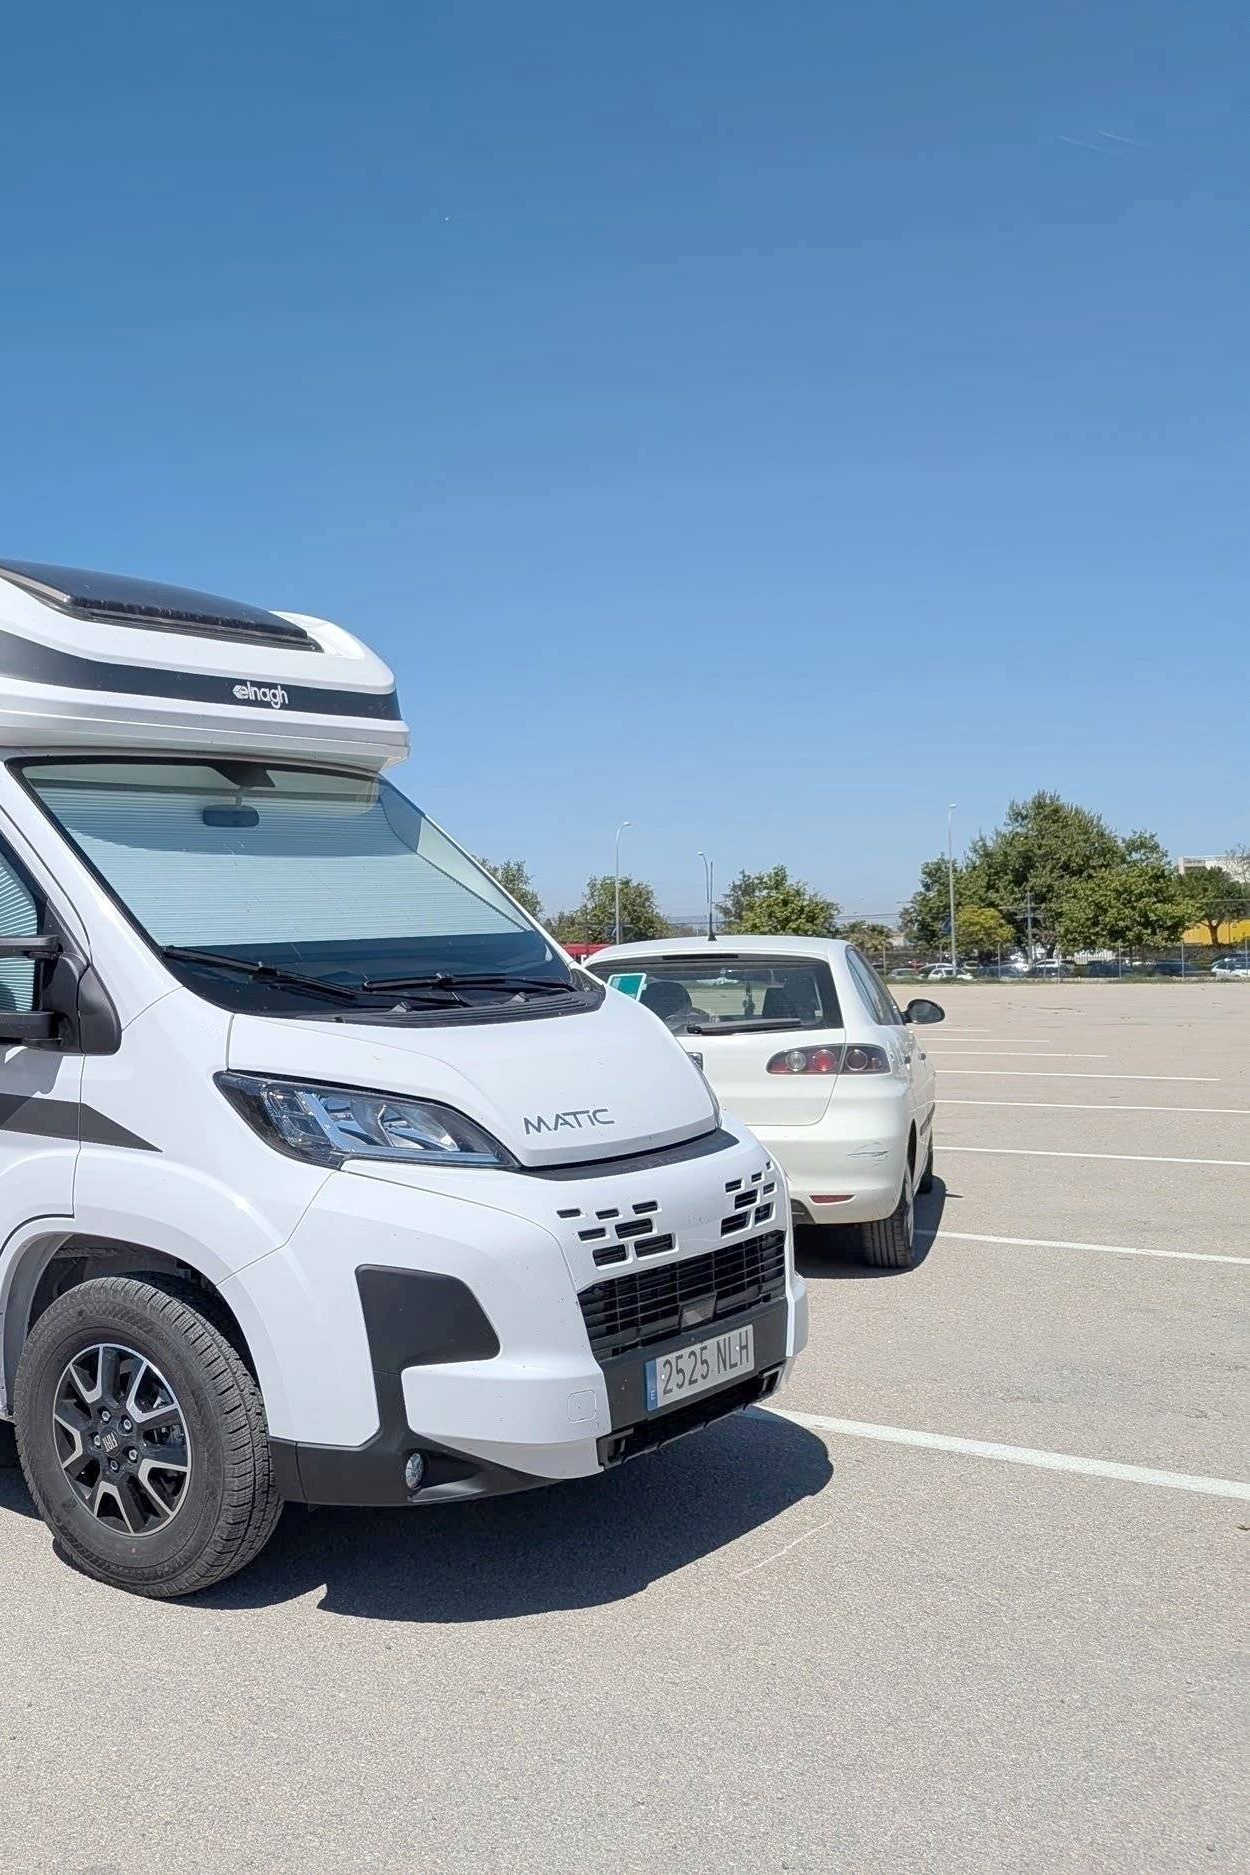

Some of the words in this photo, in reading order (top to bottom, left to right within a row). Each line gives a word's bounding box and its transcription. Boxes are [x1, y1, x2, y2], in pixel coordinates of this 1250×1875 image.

[232, 681, 289, 709] elnagh
[523, 1108, 615, 1135] MATIC
[662, 1346, 709, 1395] 2525
[716, 1330, 749, 1375] NLH
